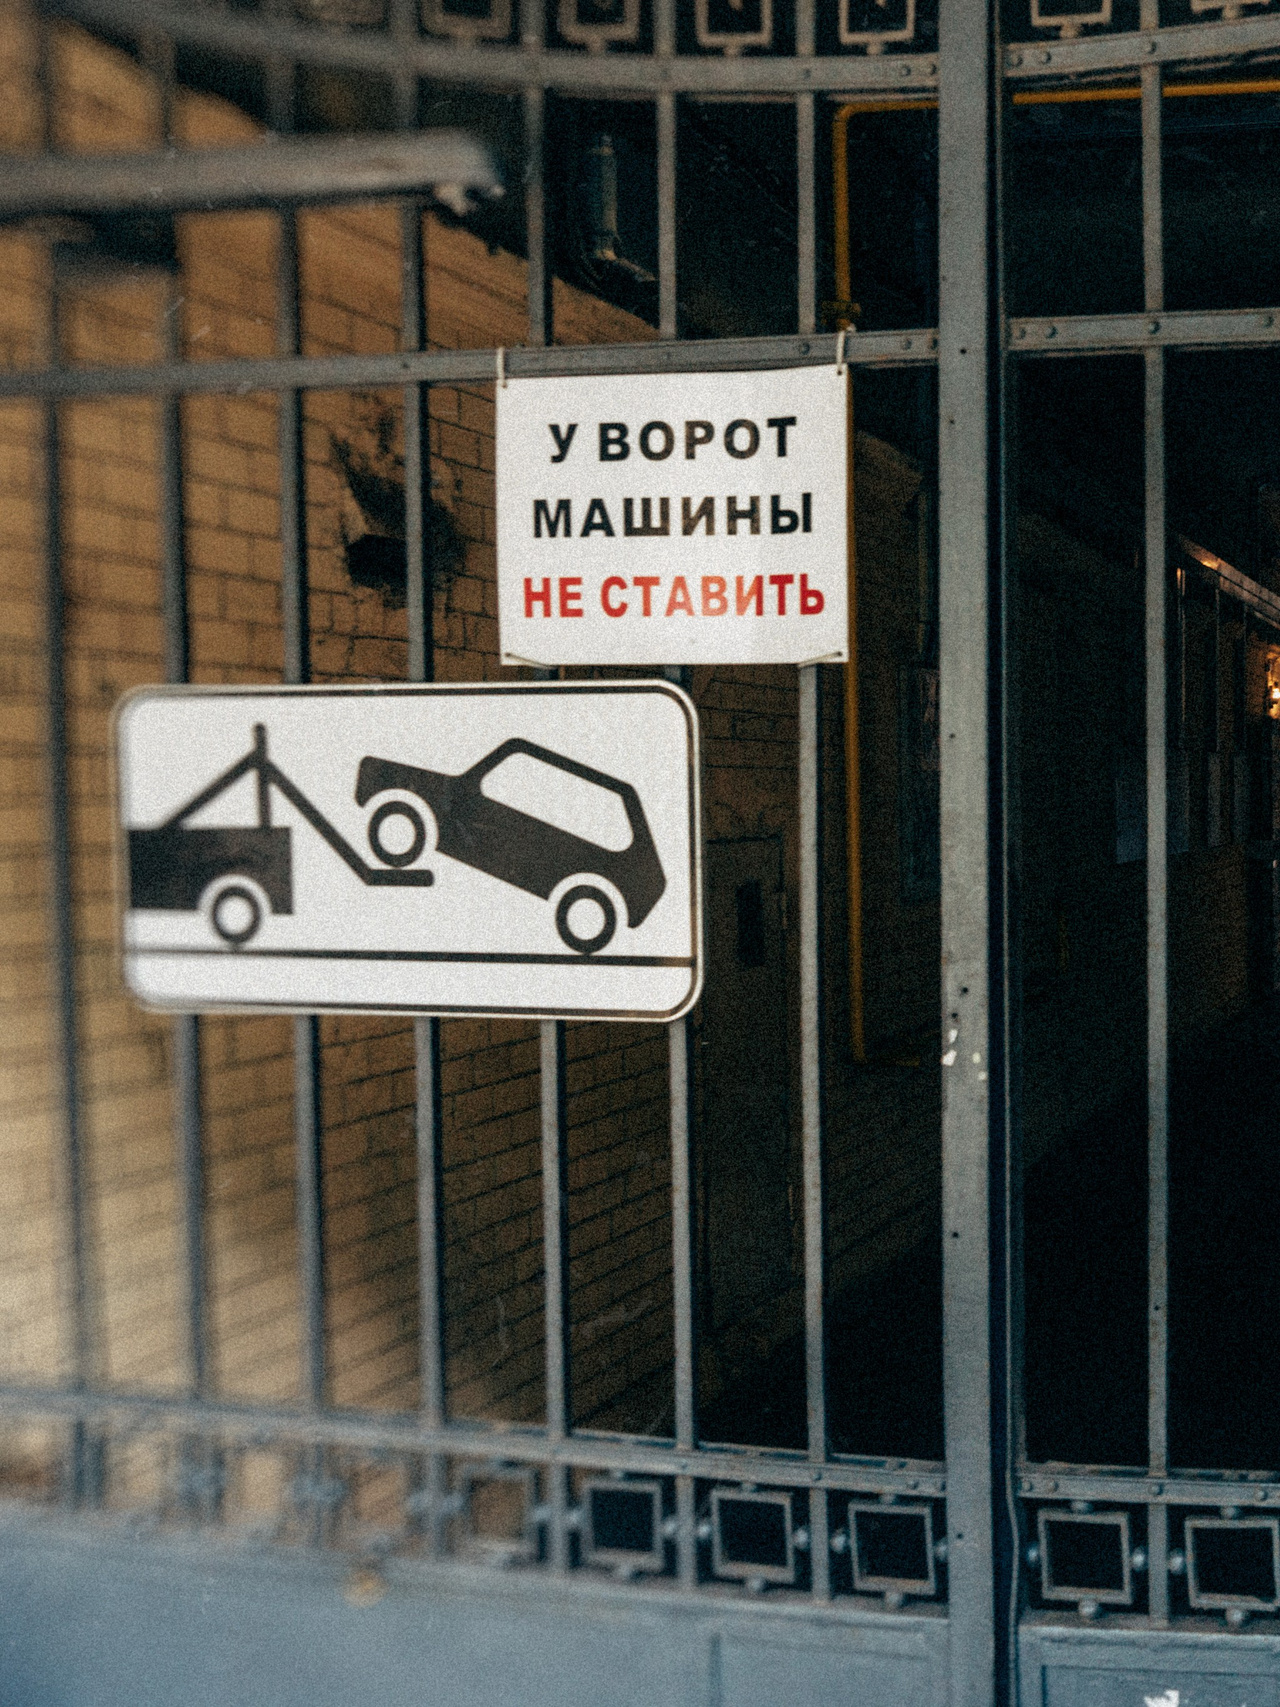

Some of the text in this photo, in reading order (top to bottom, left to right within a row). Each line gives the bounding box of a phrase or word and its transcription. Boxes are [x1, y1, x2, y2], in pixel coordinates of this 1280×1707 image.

[548, 416, 798, 464] У ВОРОТ
[532, 492, 813, 539] МАШИНЫ
[523, 573, 826, 619] НЕ СТАВИТЬ
